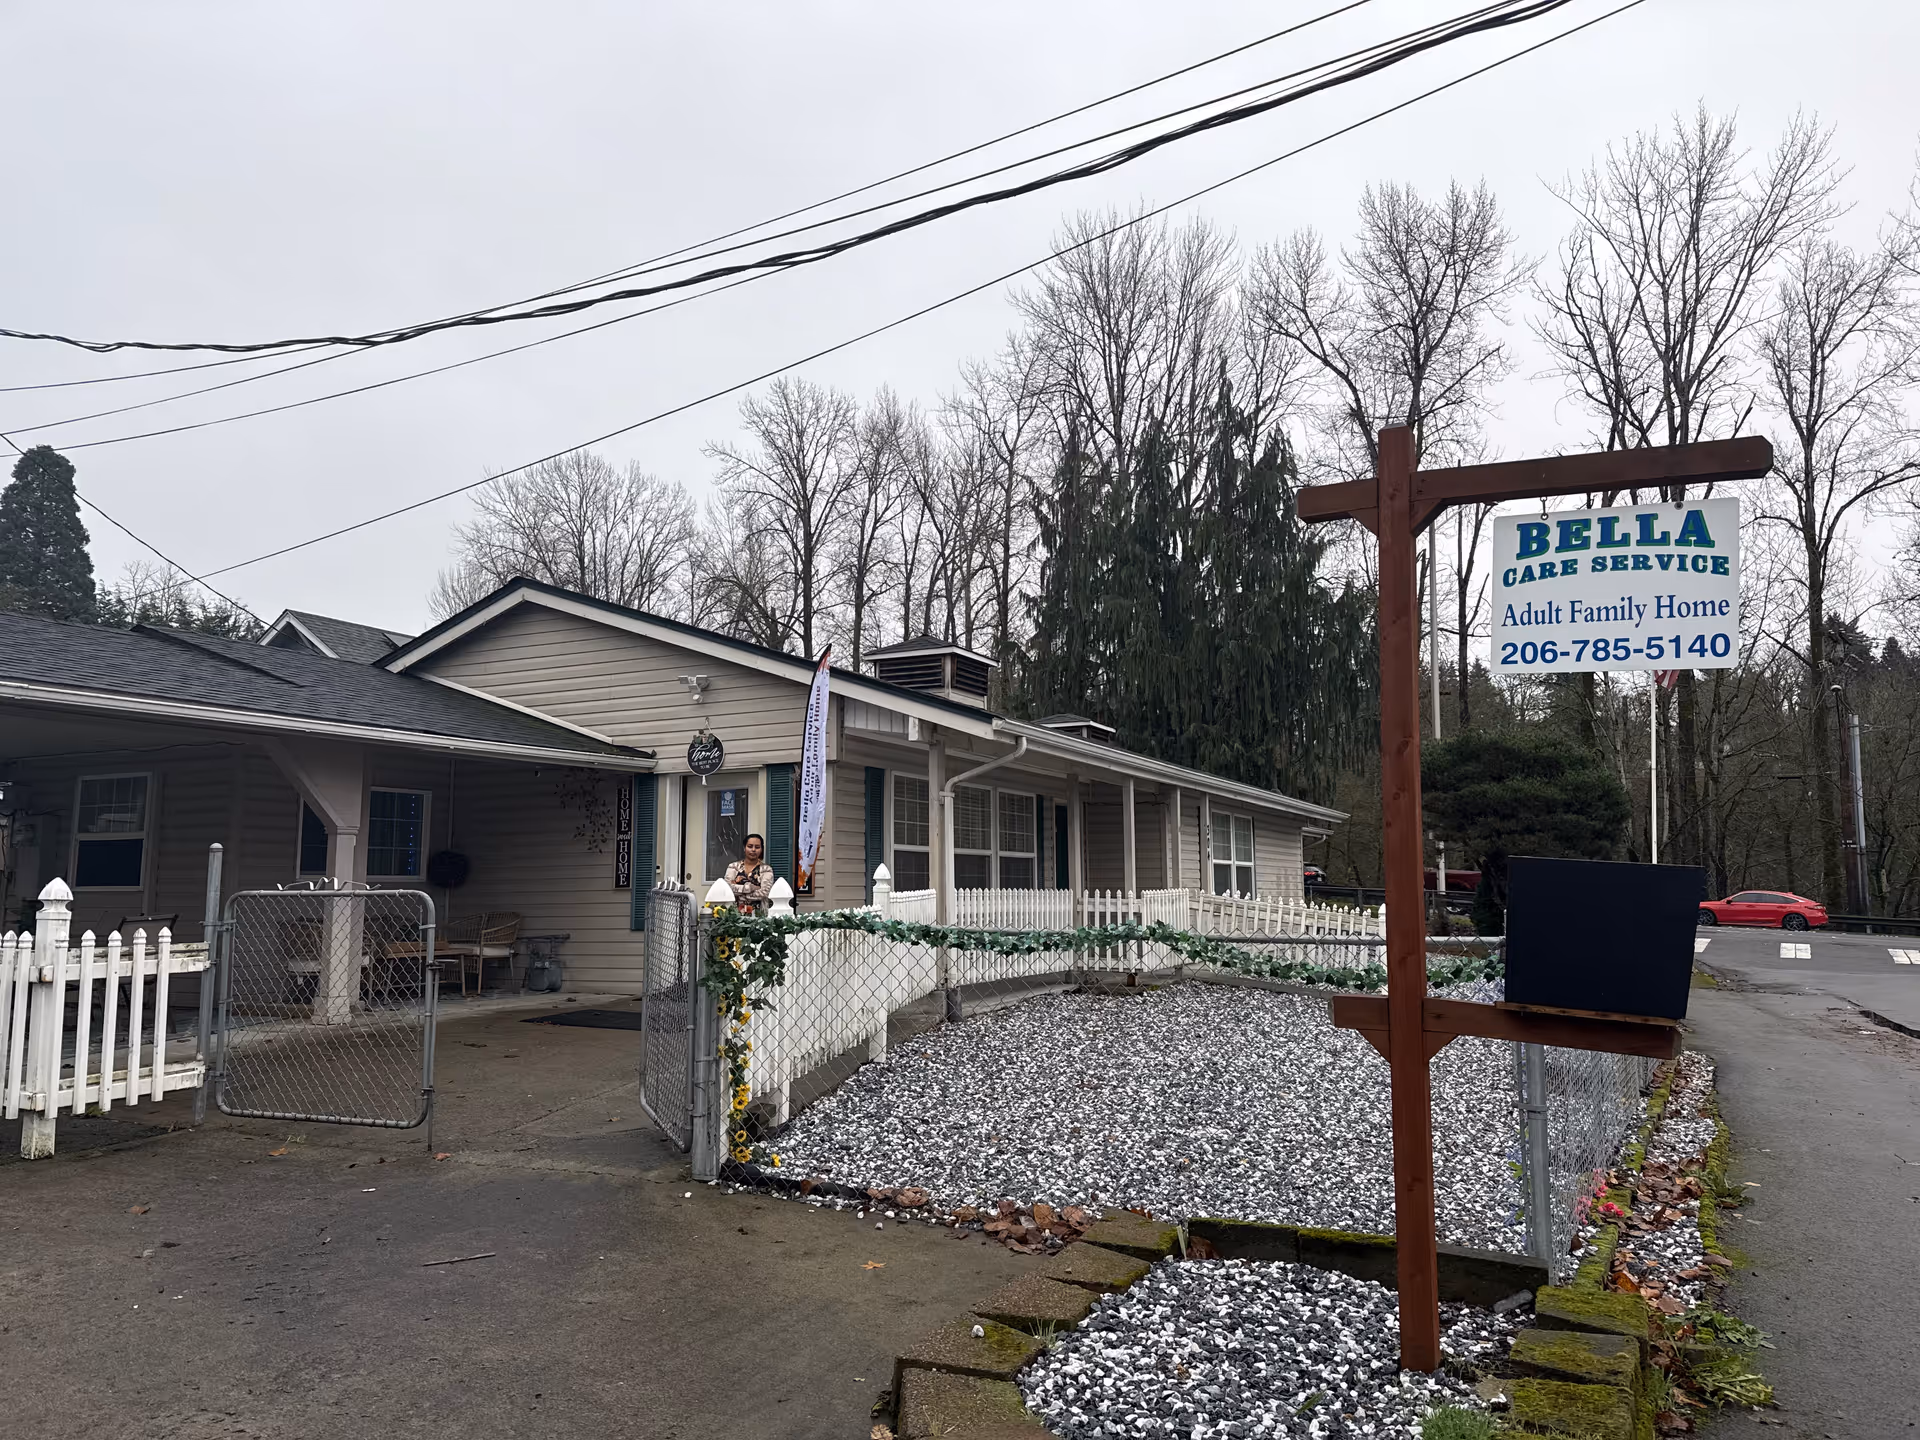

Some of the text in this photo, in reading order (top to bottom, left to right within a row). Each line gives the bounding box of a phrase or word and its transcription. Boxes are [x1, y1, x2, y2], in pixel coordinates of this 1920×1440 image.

[1516, 509, 1715, 560] BELLA
[1502, 553, 1730, 587] CARE SERVICE
[1501, 594, 1730, 628] Adult Family Home
[1500, 633, 1731, 665] 206-785-5140
[806, 704, 814, 752] Service
[690, 744, 721, 761] home
[620, 788, 630, 831] HOME
[618, 841, 628, 886] HOME
